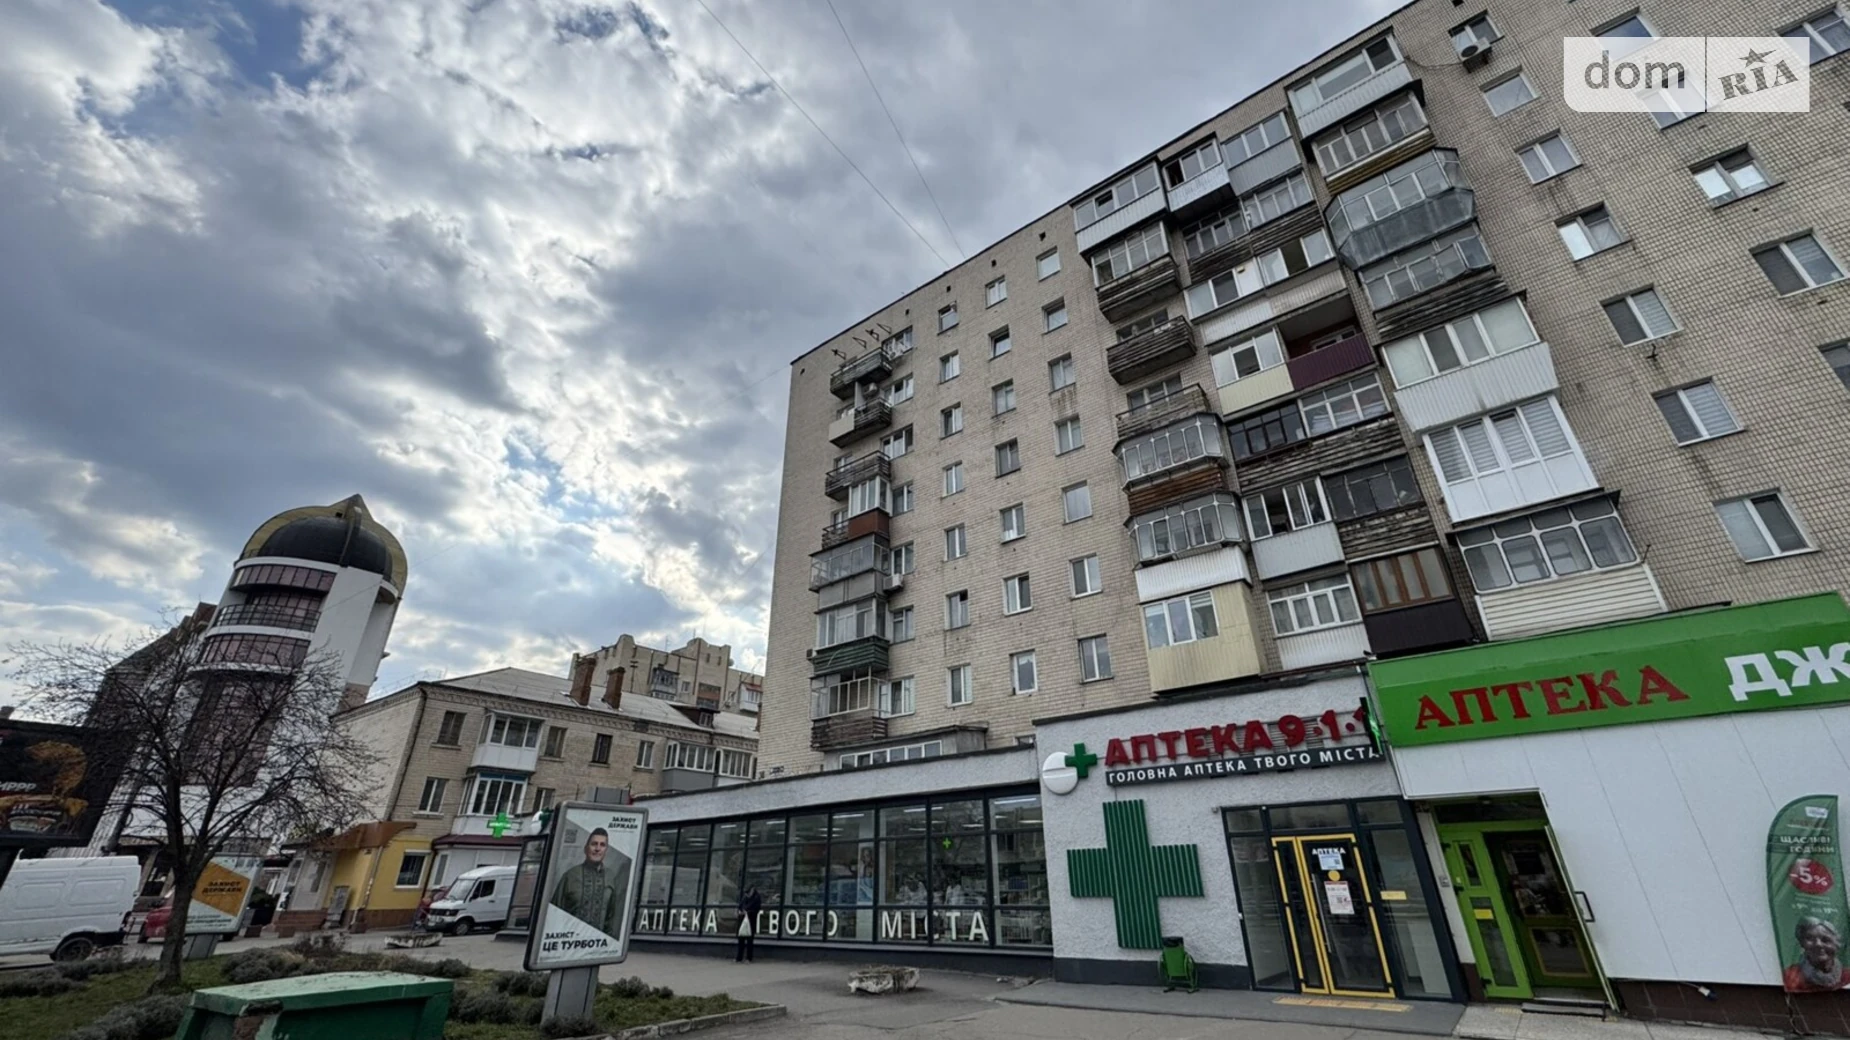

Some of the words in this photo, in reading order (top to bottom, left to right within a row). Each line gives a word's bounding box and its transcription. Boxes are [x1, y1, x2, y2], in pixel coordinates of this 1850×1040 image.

[1414, 665, 1691, 730] АПТЕКА
[1104, 719, 1274, 767] АПТЕКА
[1109, 767, 1177, 783] ГОЛОВНА
[1184, 759, 1247, 776] АПТЕКА
[1253, 752, 1311, 769] ТВОГО
[543, 941, 559, 953] ЦЕ
[561, 938, 608, 951] ТУРБОТА
[545, 932, 574, 940] ЗАХИСТ
